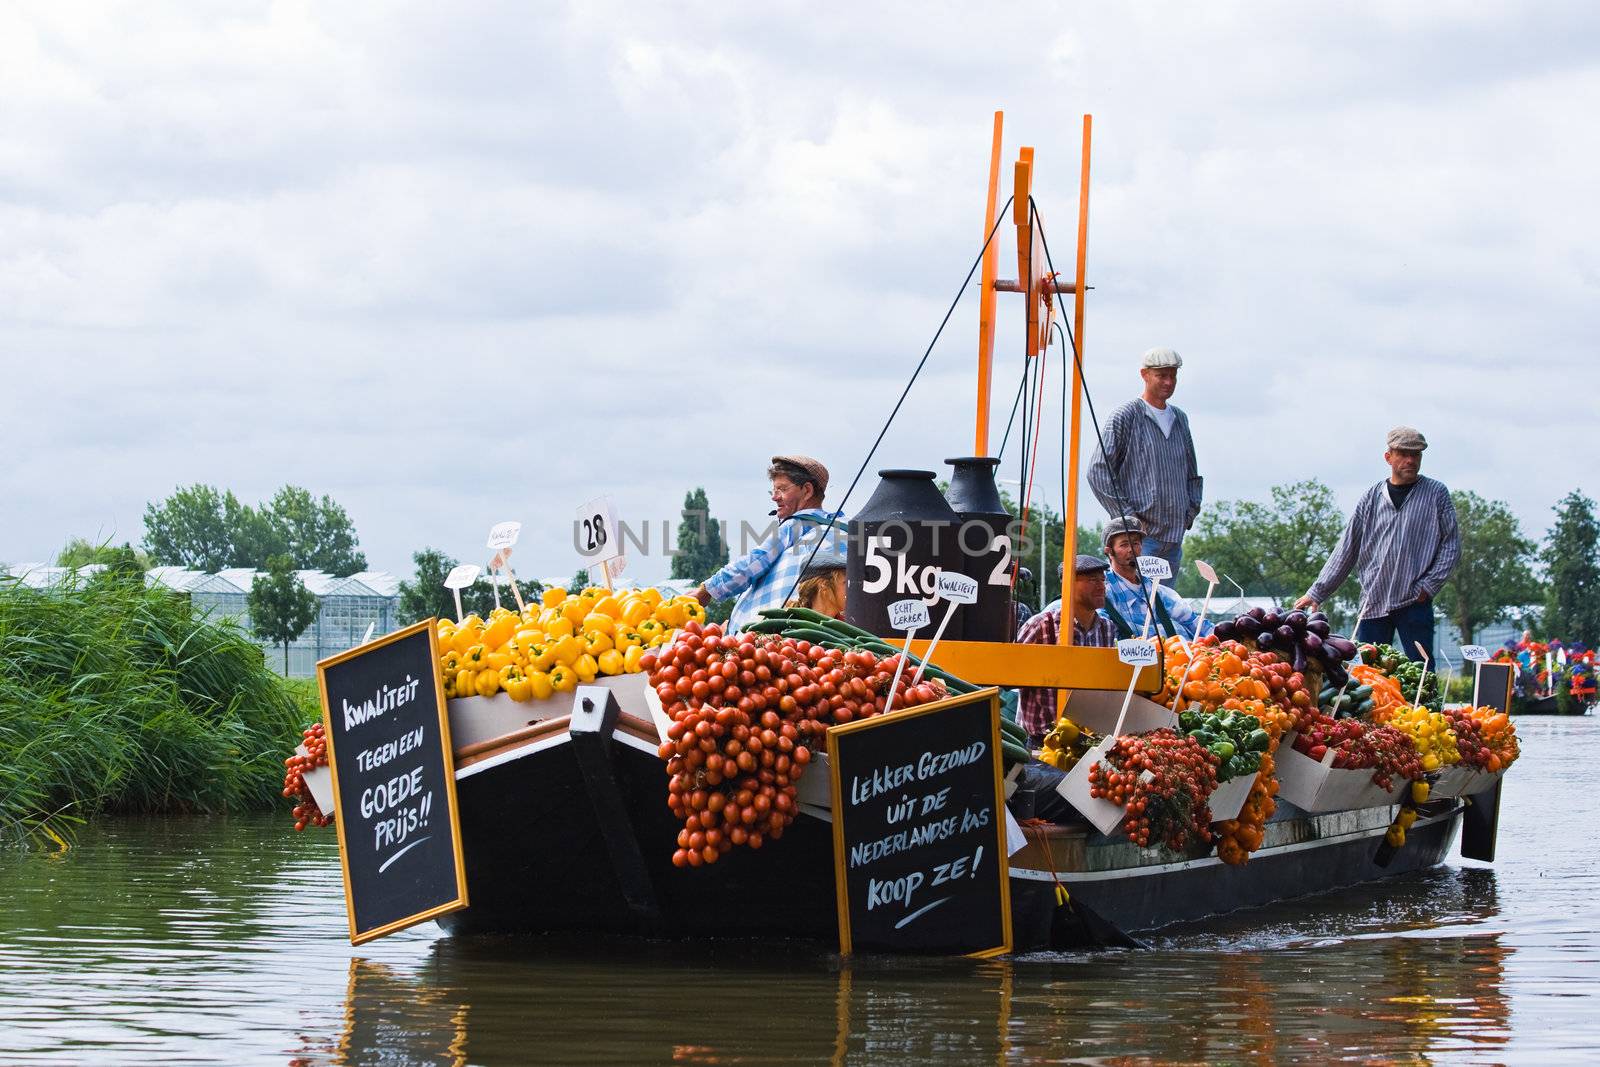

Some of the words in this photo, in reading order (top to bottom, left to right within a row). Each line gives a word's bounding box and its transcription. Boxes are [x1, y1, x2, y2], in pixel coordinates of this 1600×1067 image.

[583, 513, 607, 550] 28
[862, 536, 943, 607] 5kg
[893, 612, 928, 625] LEKKER!
[894, 602, 914, 615] ECHT
[355, 741, 398, 774] TEGEN
[399, 726, 424, 754] EEN
[852, 768, 915, 806] LEKKER
[917, 741, 986, 781] GEZOND
[360, 766, 424, 819] GOEDE
[920, 787, 951, 817] DE
[850, 815, 958, 869] NEDERLANDSE
[960, 807, 990, 834] KAS
[867, 871, 924, 911] KOOP
[930, 845, 984, 888] ZE!
